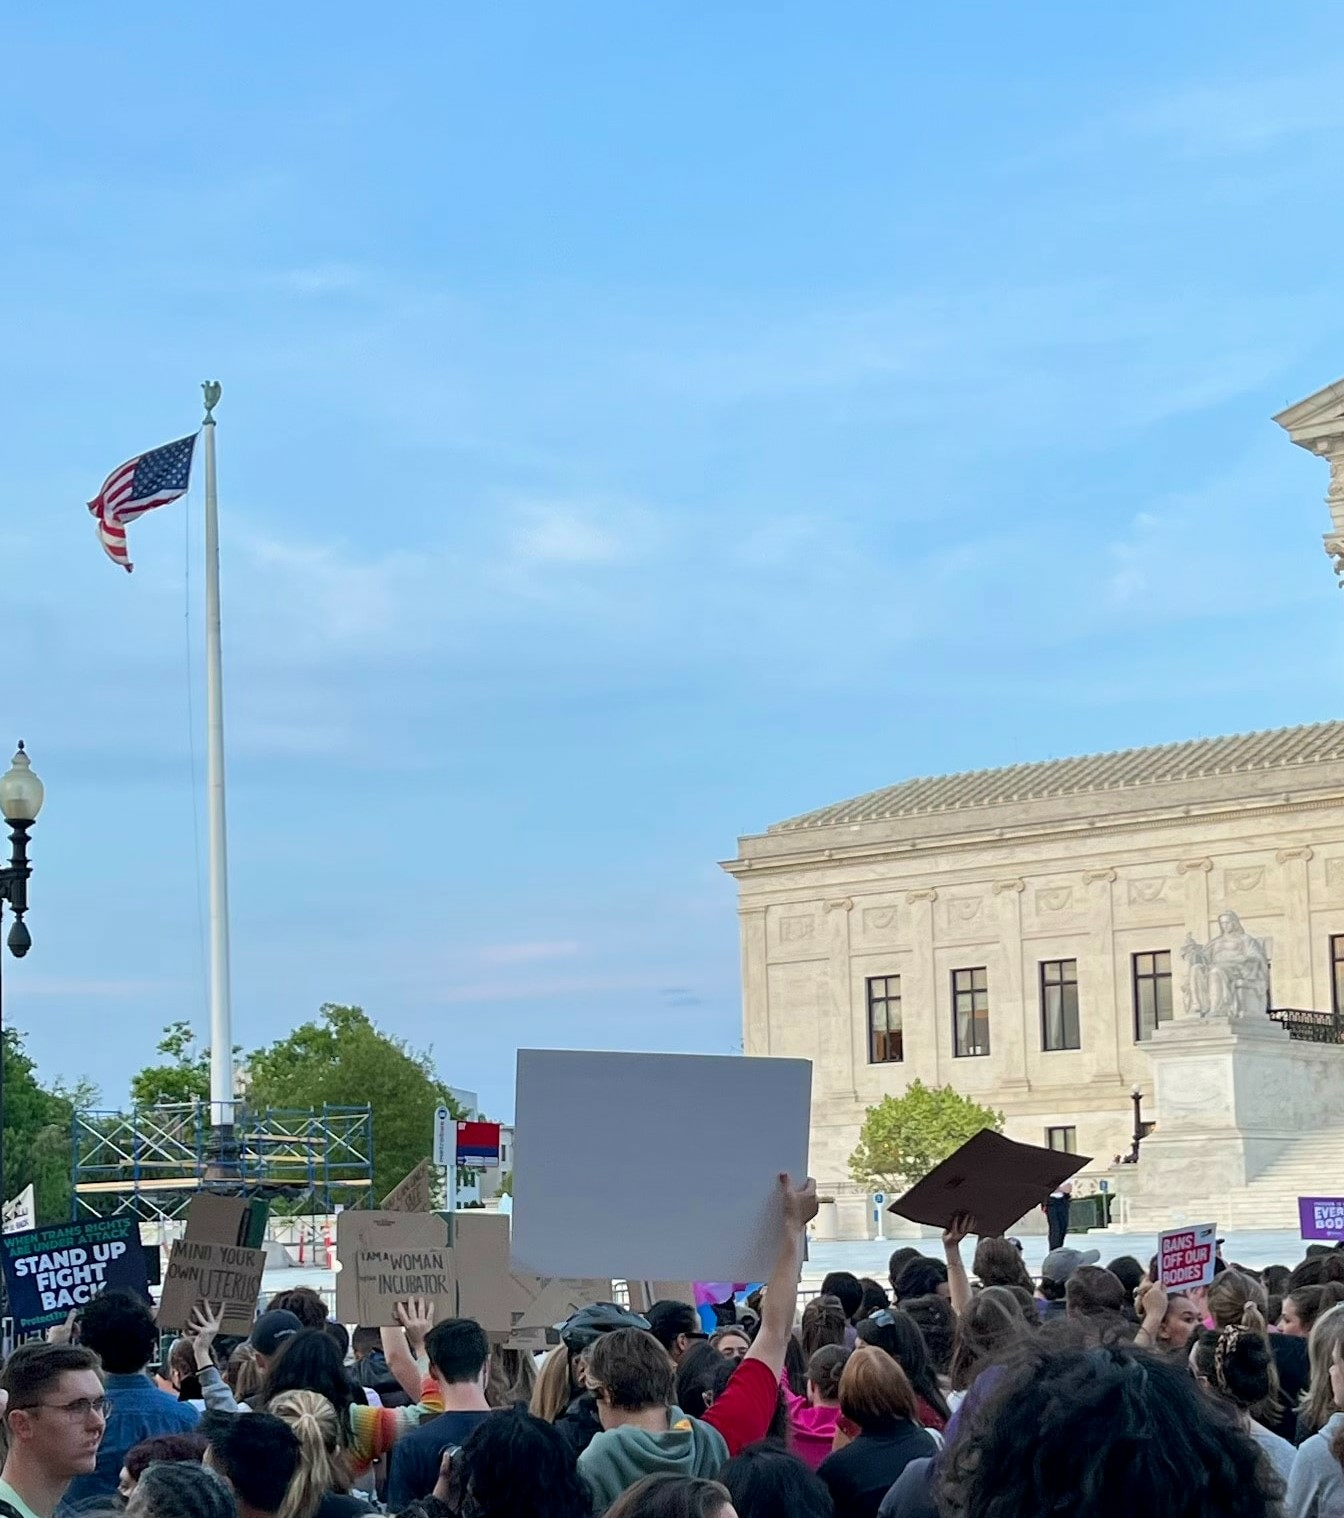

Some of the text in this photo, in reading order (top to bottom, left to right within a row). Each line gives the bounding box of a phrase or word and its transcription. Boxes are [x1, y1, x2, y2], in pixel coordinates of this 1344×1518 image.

[4, 1217, 132, 1248] WHEN TRANS RIGHTS
[8, 1228, 130, 1258] ARE UNDER ATTACK
[1163, 1234, 1193, 1254] BANS
[14, 1241, 127, 1277] STAND UP
[173, 1241, 256, 1266] MIND YOUR
[390, 1254, 444, 1271] WOMAN
[1163, 1246, 1208, 1270] OFF OUR
[36, 1262, 107, 1292] FIGHT
[168, 1263, 260, 1303] OWN UTERUS
[378, 1274, 449, 1295] INCUBATOR
[1163, 1264, 1202, 1285] BODIES
[40, 1281, 108, 1311] BACK
